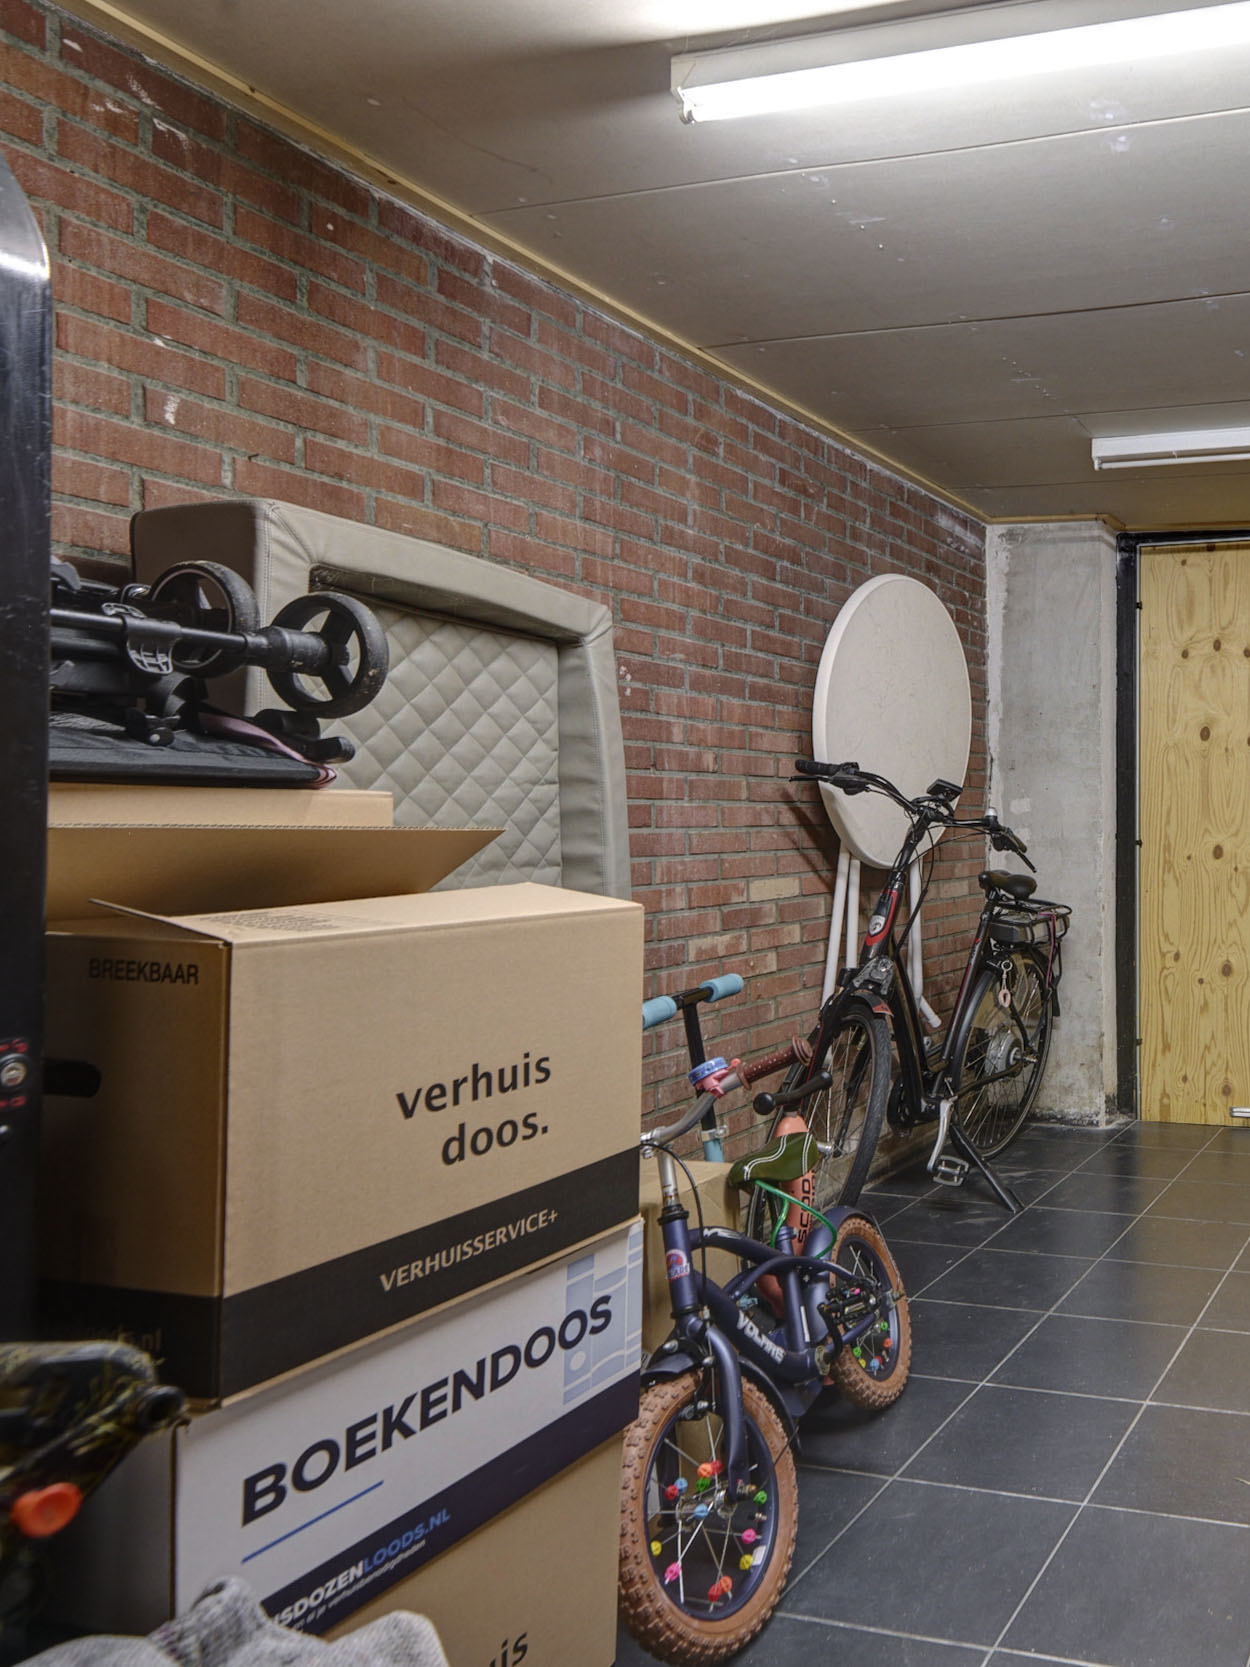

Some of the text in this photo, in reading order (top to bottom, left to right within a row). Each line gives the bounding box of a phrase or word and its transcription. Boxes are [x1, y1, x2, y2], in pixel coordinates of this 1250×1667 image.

[89, 958, 199, 985] BREEKBAAR
[395, 1052, 552, 1120] verhuis
[441, 1112, 549, 1166] doos.
[379, 1208, 559, 1292] VERHUISSERVICE+
[736, 1310, 787, 1365] VOLARE
[241, 1294, 613, 1528] BOEKENDOOS
